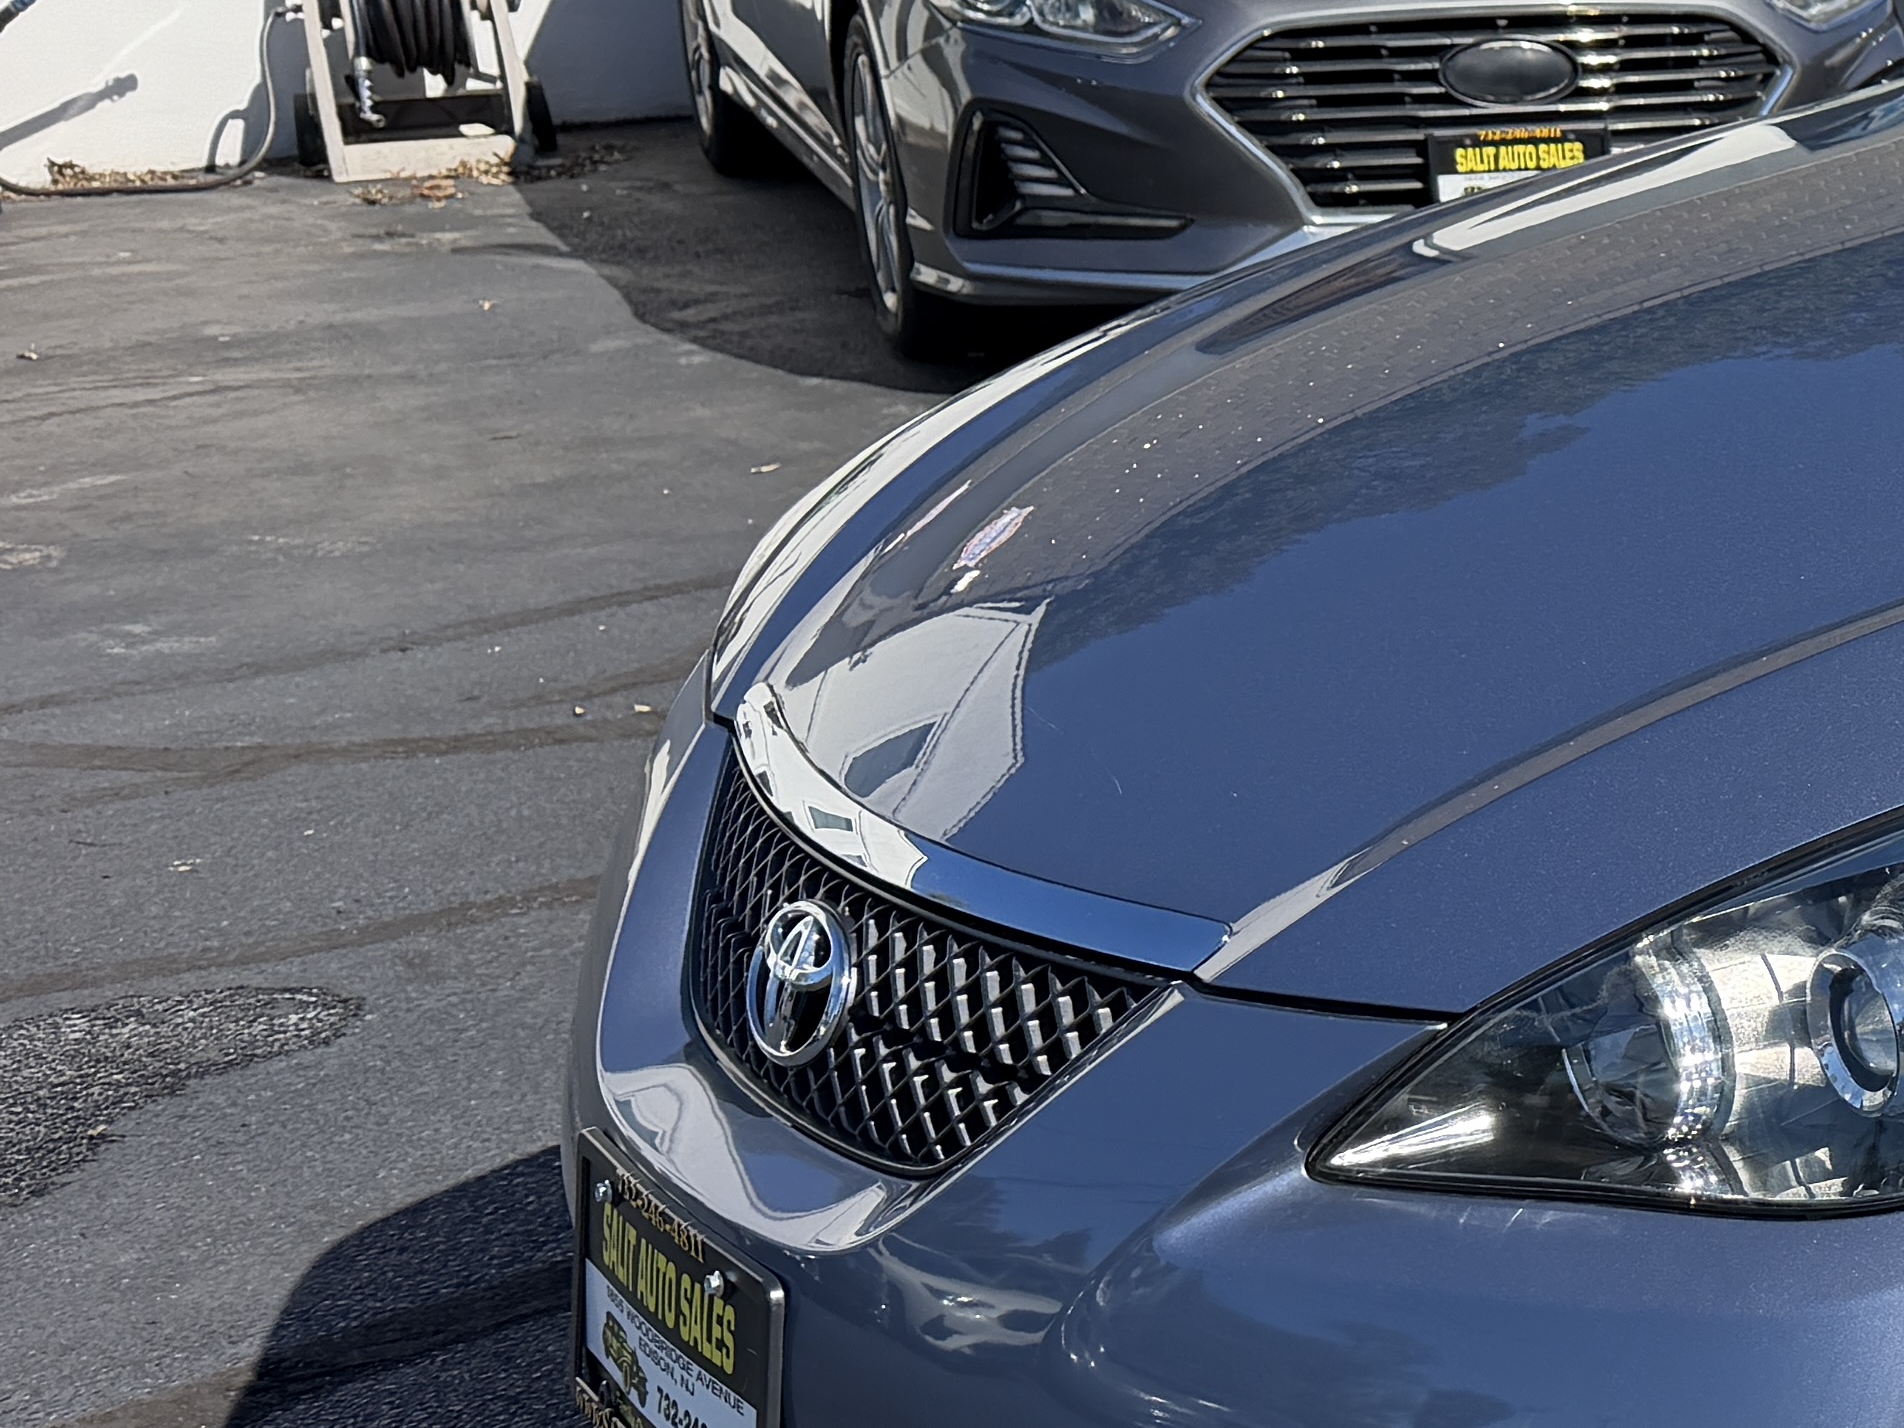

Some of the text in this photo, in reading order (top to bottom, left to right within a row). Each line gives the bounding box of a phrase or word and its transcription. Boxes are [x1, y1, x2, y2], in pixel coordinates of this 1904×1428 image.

[1454, 141, 1585, 173] SALIT AUTO SALES
[602, 1202, 736, 1375] SALIT AUTO SALES
[626, 1307, 694, 1378] WOODBRIDGE
[696, 1372, 745, 1416] AVENUE
[680, 1377, 695, 1397] NJ
